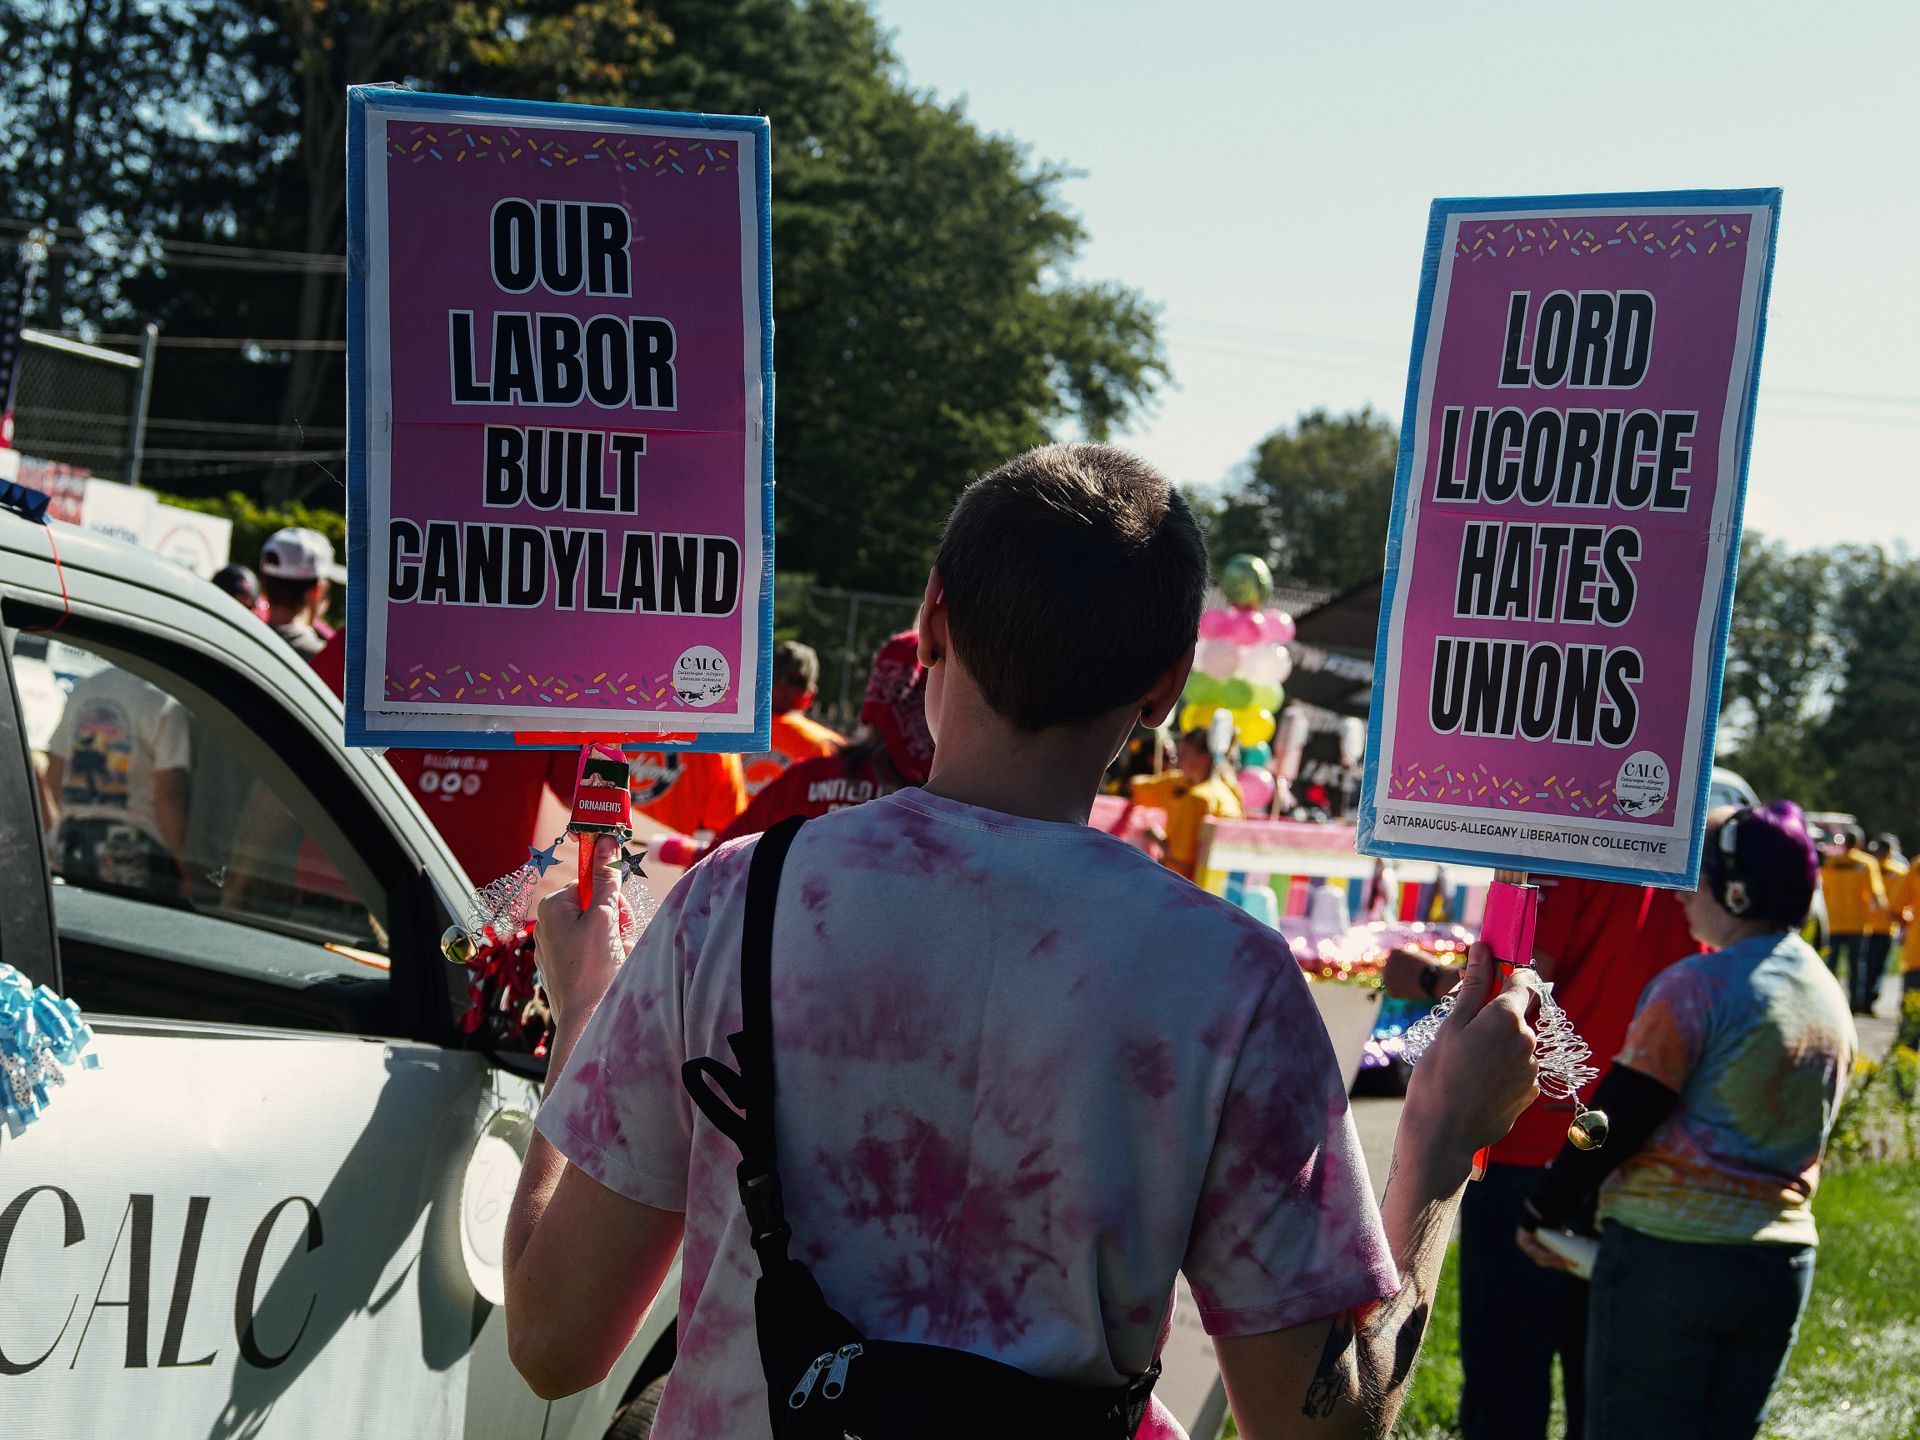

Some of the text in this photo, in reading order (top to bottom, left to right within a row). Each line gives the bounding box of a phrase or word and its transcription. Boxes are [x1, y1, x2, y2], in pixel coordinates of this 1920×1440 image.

[490, 198, 632, 298] OUR
[449, 309, 678, 412] LABOR
[1498, 289, 1656, 390] LORD
[483, 424, 647, 516] BUILT
[1433, 405, 1699, 513] LICORICE
[388, 517, 742, 618] CANDYLAND
[1453, 520, 1642, 628] HATES
[680, 657, 722, 671] CALC
[1428, 635, 1644, 749] UNIONS
[579, 799, 621, 813] ORNAMENTS
[1624, 762, 1664, 779] CALC
[1382, 814, 1667, 854] CATTARAUGUS-ALLEGANY LIBERATION COLLECTIVE
[0, 1185, 324, 1376] CALC
